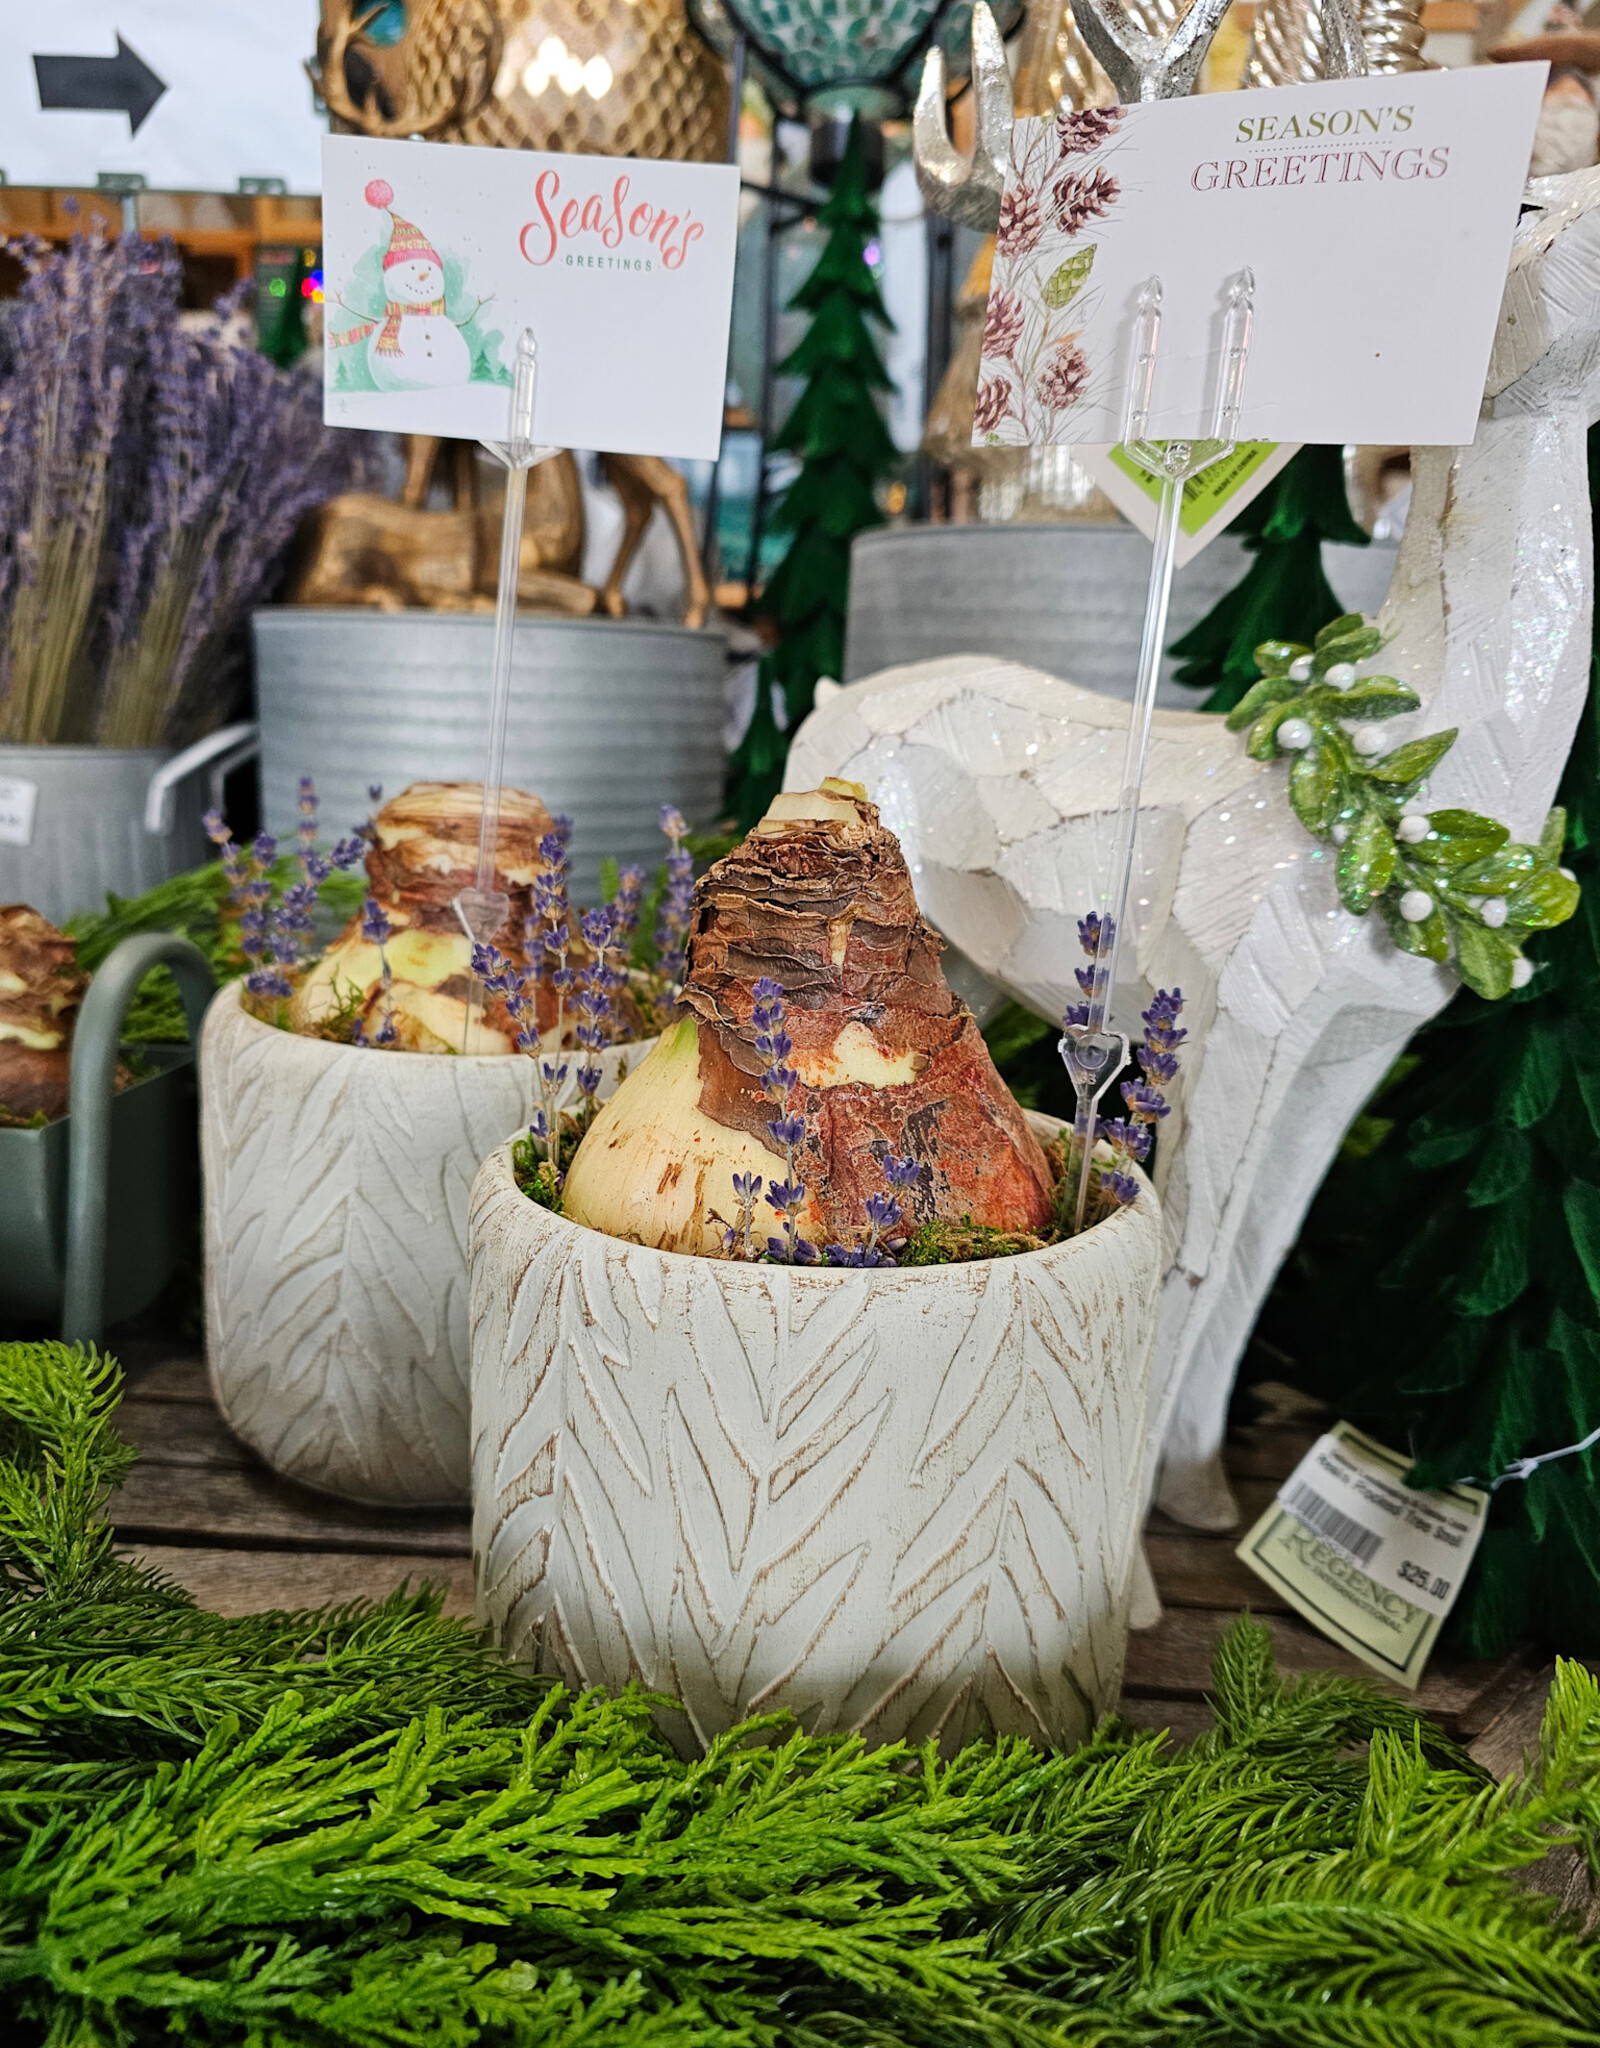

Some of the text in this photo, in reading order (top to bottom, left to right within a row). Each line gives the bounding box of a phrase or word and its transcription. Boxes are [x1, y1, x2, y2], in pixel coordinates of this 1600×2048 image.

[1235, 104, 1415, 144] SEASON'S
[1189, 146, 1451, 192] GREETINGS
[519, 169, 705, 271] Season's
[566, 254, 652, 272] GREETINGS
[1397, 1560, 1450, 1600] $25.00
